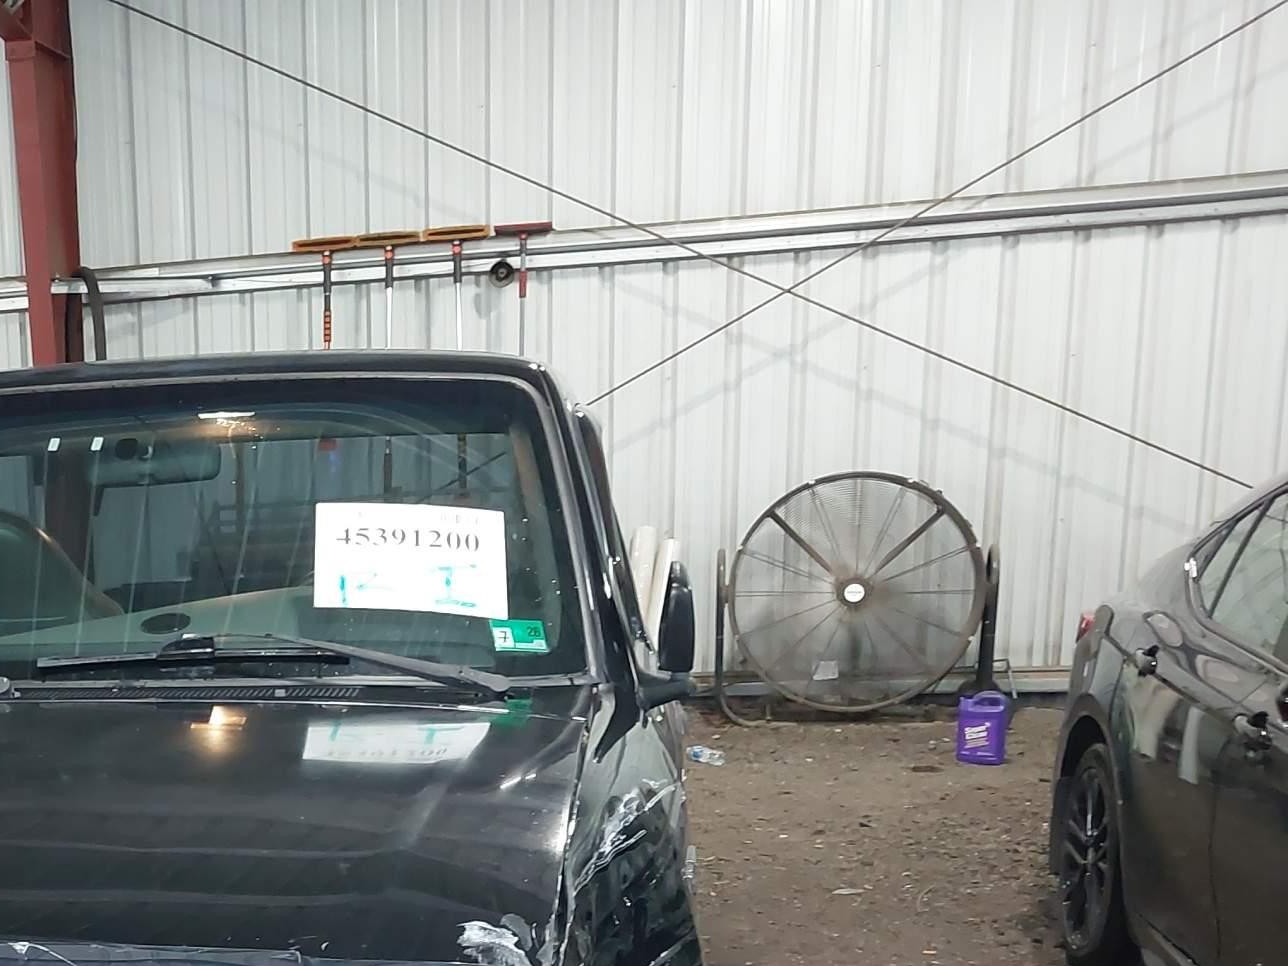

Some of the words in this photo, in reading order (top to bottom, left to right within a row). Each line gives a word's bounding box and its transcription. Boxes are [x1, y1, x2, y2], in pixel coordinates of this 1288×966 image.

[336, 528, 480, 552] 45391200
[497, 630, 509, 643] 7
[527, 626, 541, 638] 26
